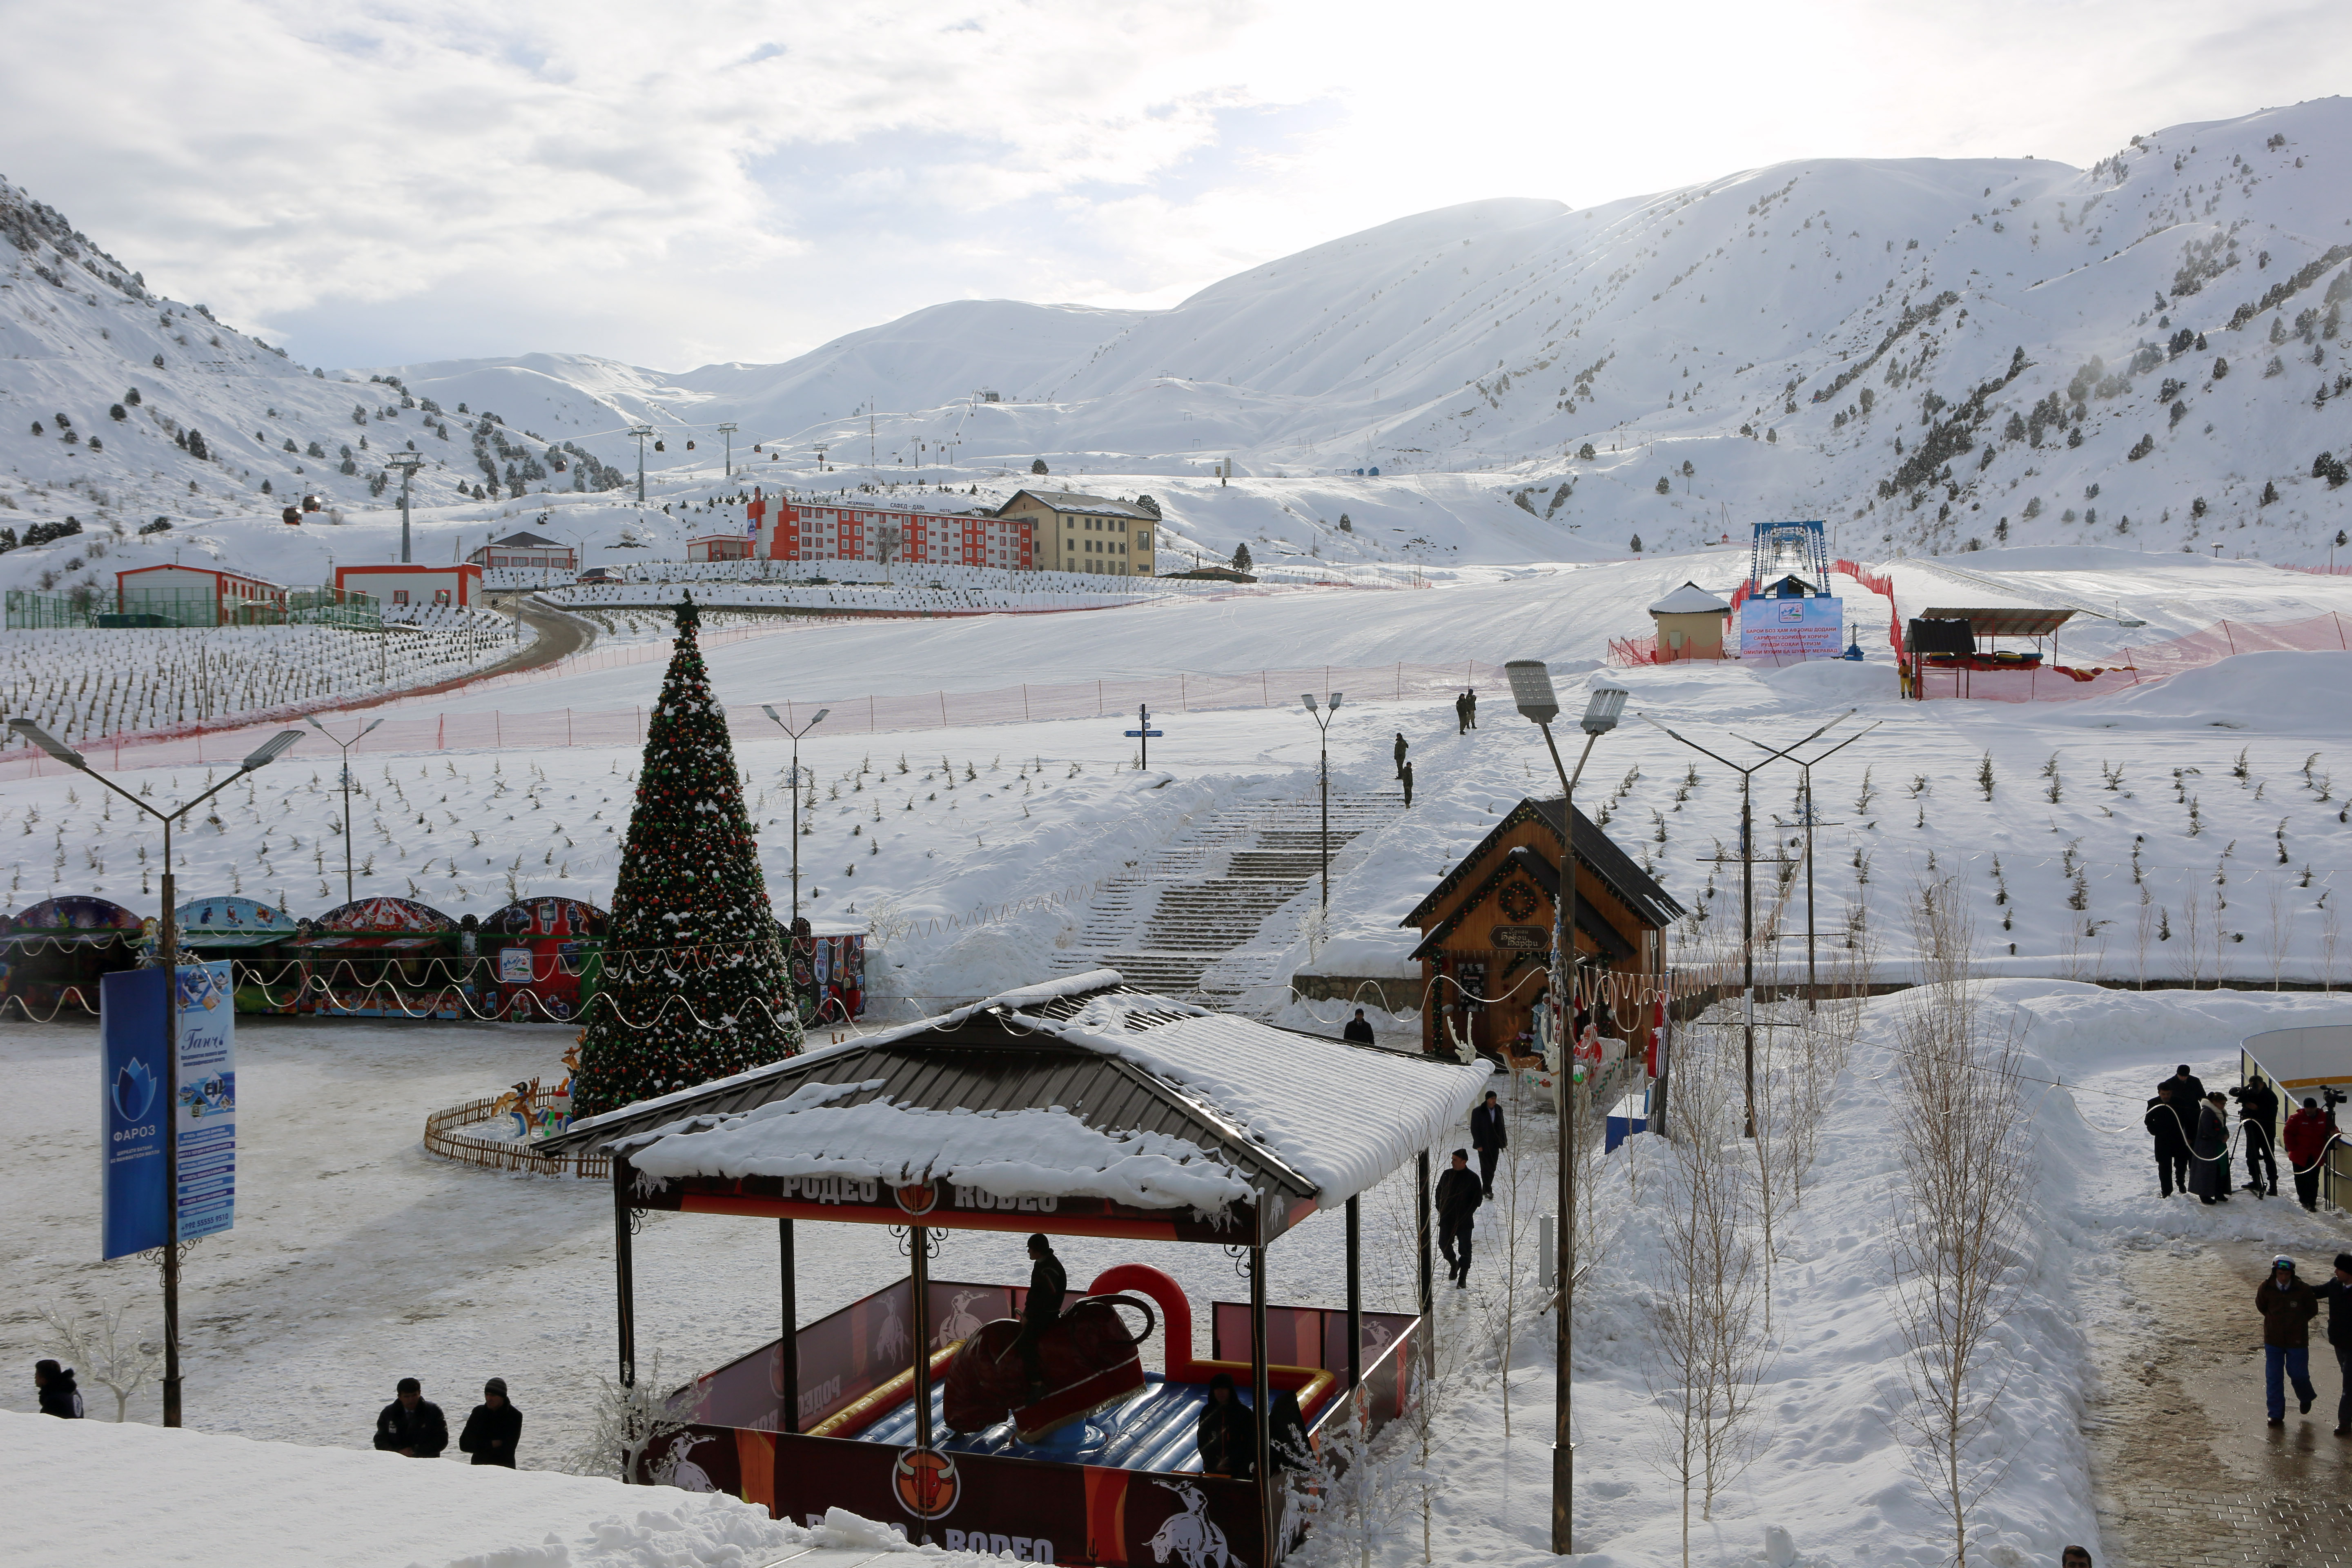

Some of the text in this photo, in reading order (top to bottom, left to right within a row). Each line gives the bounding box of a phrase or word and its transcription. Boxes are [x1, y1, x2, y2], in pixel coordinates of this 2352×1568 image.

[114, 1125, 155, 1142] ФАРОЗ
[783, 1176, 878, 1205] РОДЕО
[181, 1221, 195, 1230] +992
[197, 1217, 214, 1227] 55555
[215, 1213, 228, 1222] 9510
[945, 1528, 1054, 1564] RODEO
